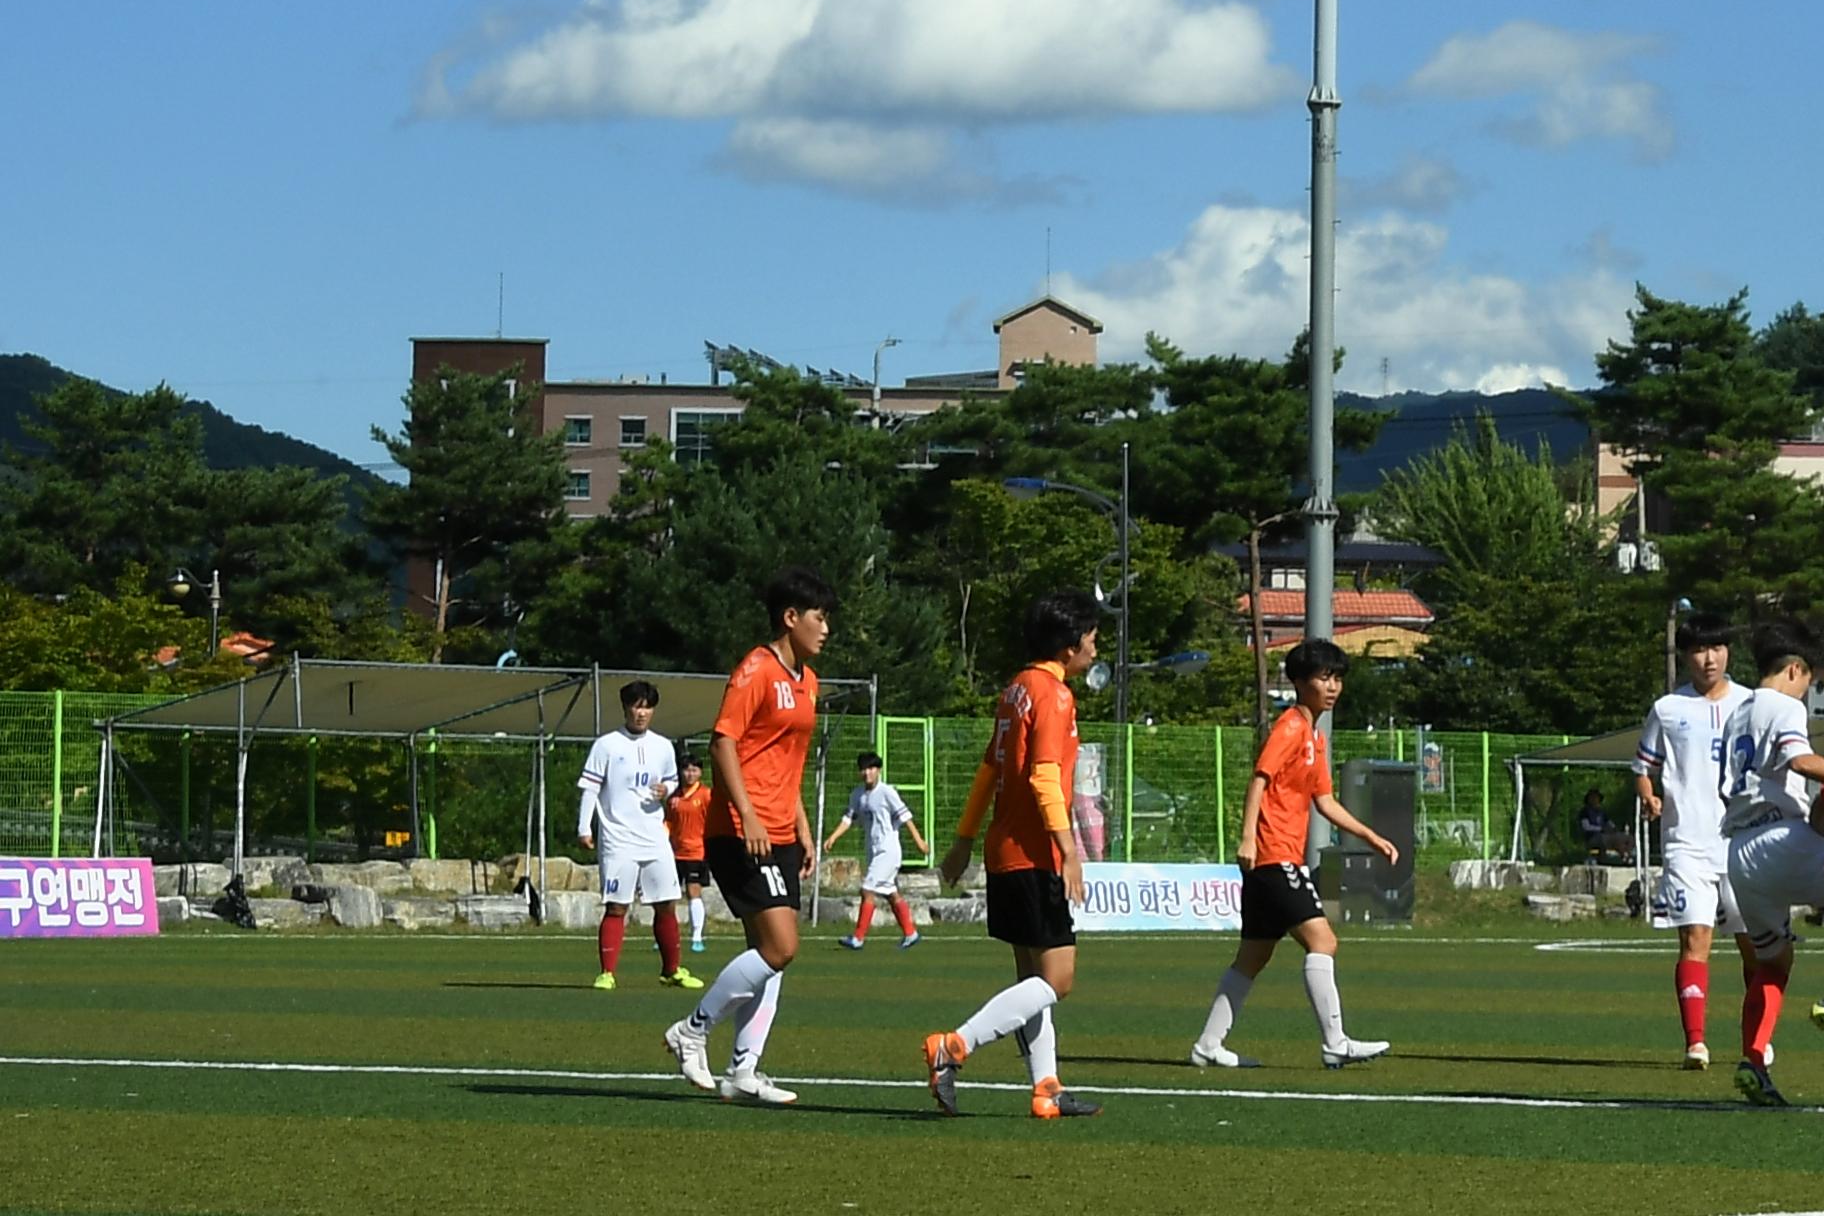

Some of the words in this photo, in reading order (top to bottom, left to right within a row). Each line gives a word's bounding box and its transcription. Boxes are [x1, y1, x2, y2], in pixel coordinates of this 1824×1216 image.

[773, 681, 796, 710] 18
[1306, 740, 1315, 766] 3
[1710, 737, 1721, 762] 5
[635, 772, 649, 787] 10
[606, 879, 619, 894] 10
[761, 865, 788, 897] 18
[0, 867, 145, 927] 구연맹전
[1083, 881, 1131, 914] 2019
[1137, 880, 1183, 917] 화천
[1676, 889, 1688, 913] 5
